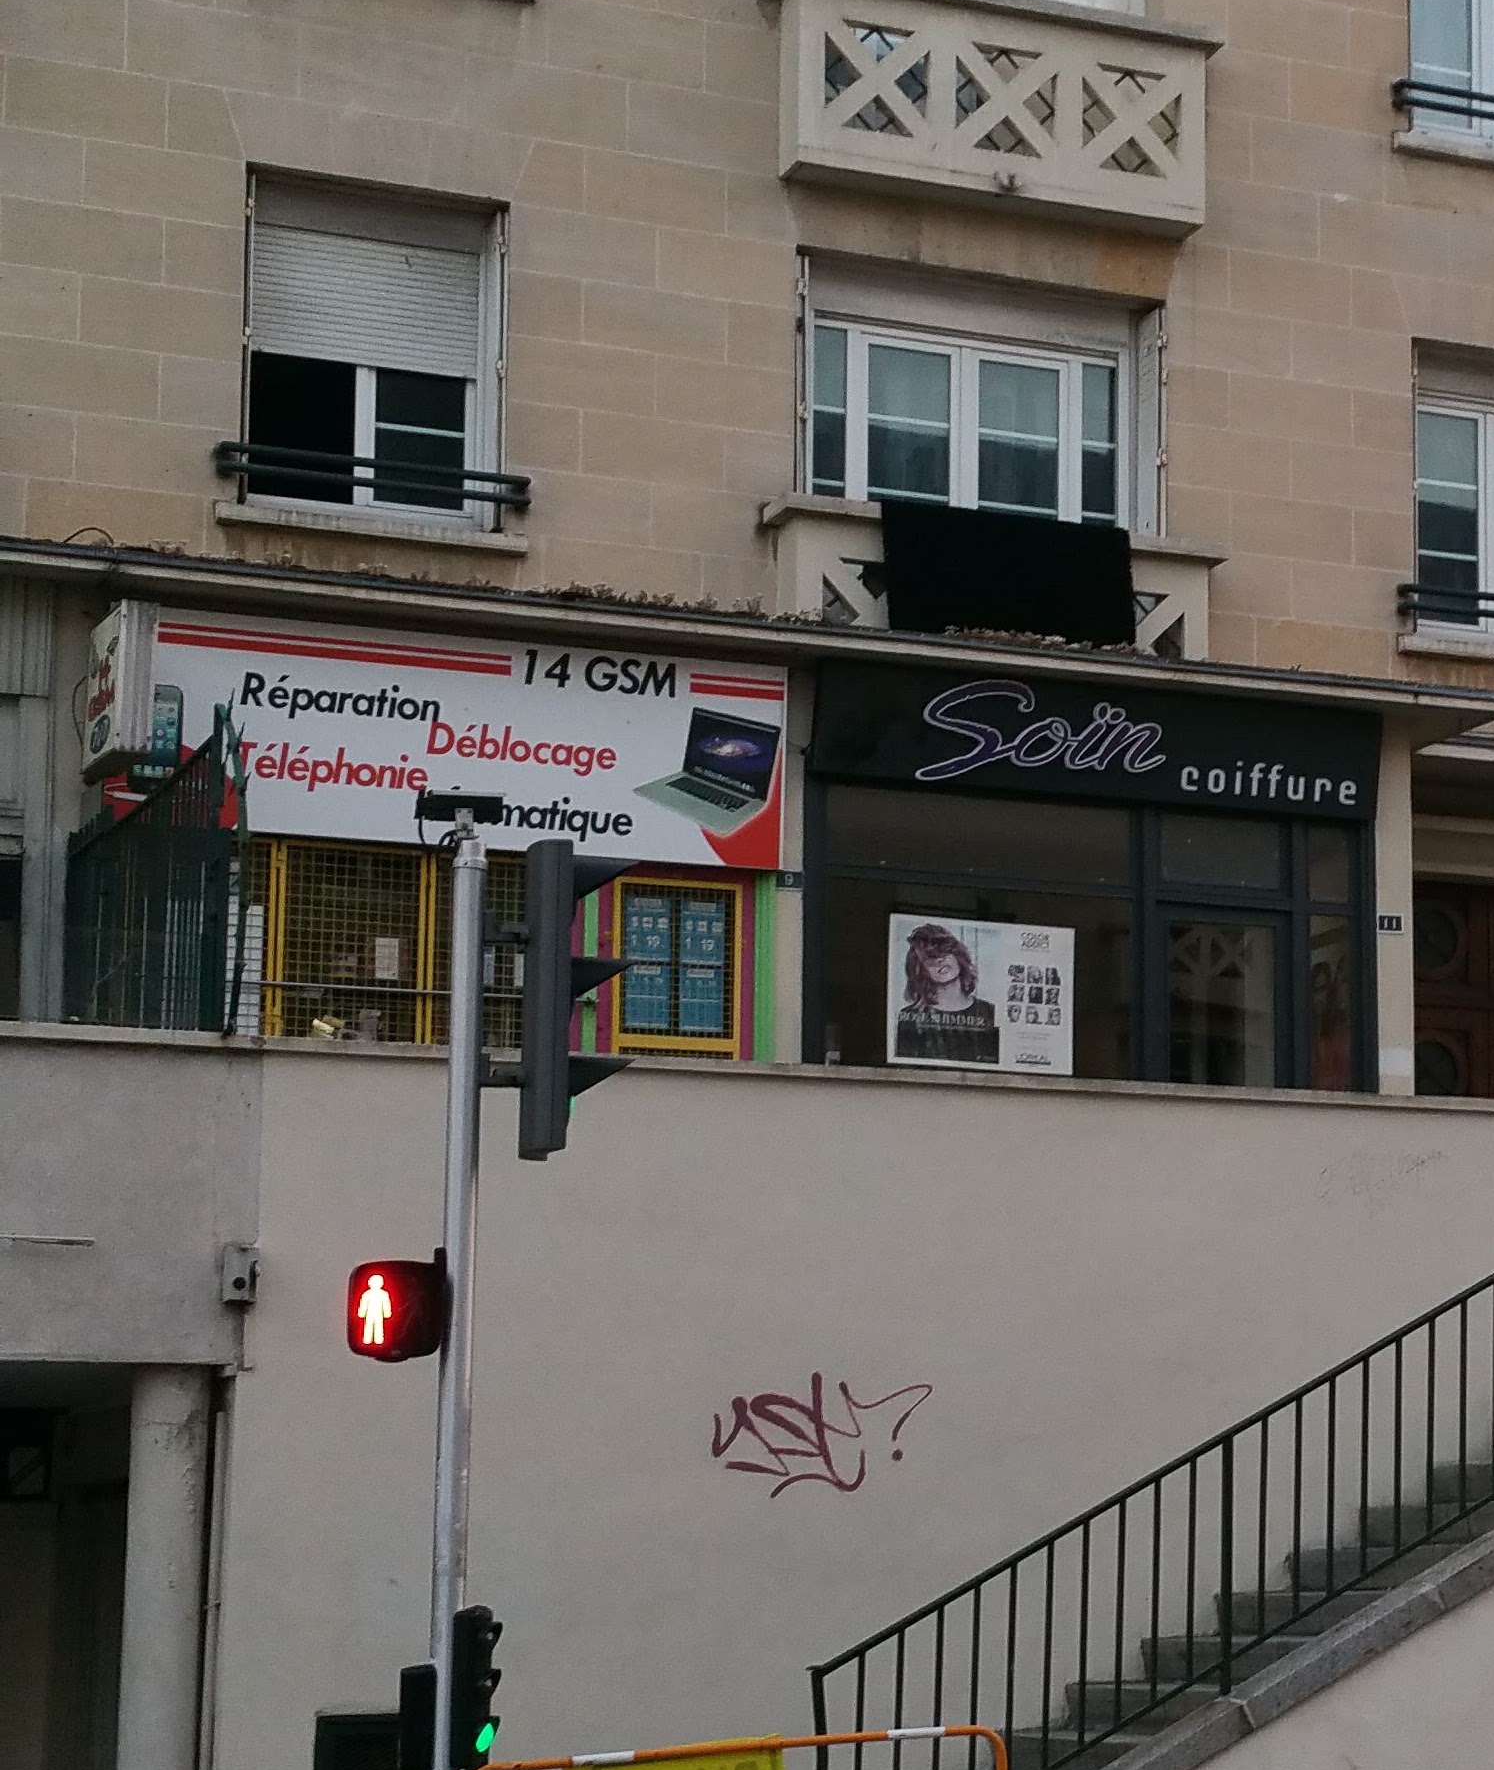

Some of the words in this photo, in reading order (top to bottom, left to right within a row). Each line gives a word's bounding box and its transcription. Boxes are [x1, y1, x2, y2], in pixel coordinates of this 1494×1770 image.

[240, 672, 440, 721] Réparation
[525, 649, 570, 688] 14
[585, 656, 676, 698] GSM
[239, 742, 428, 792] Téléphonie
[427, 721, 617, 776] Déblocage
[1180, 761, 1357, 806] coiffure
[784, 873, 794, 886] 9
[1383, 917, 1397, 929] 11
